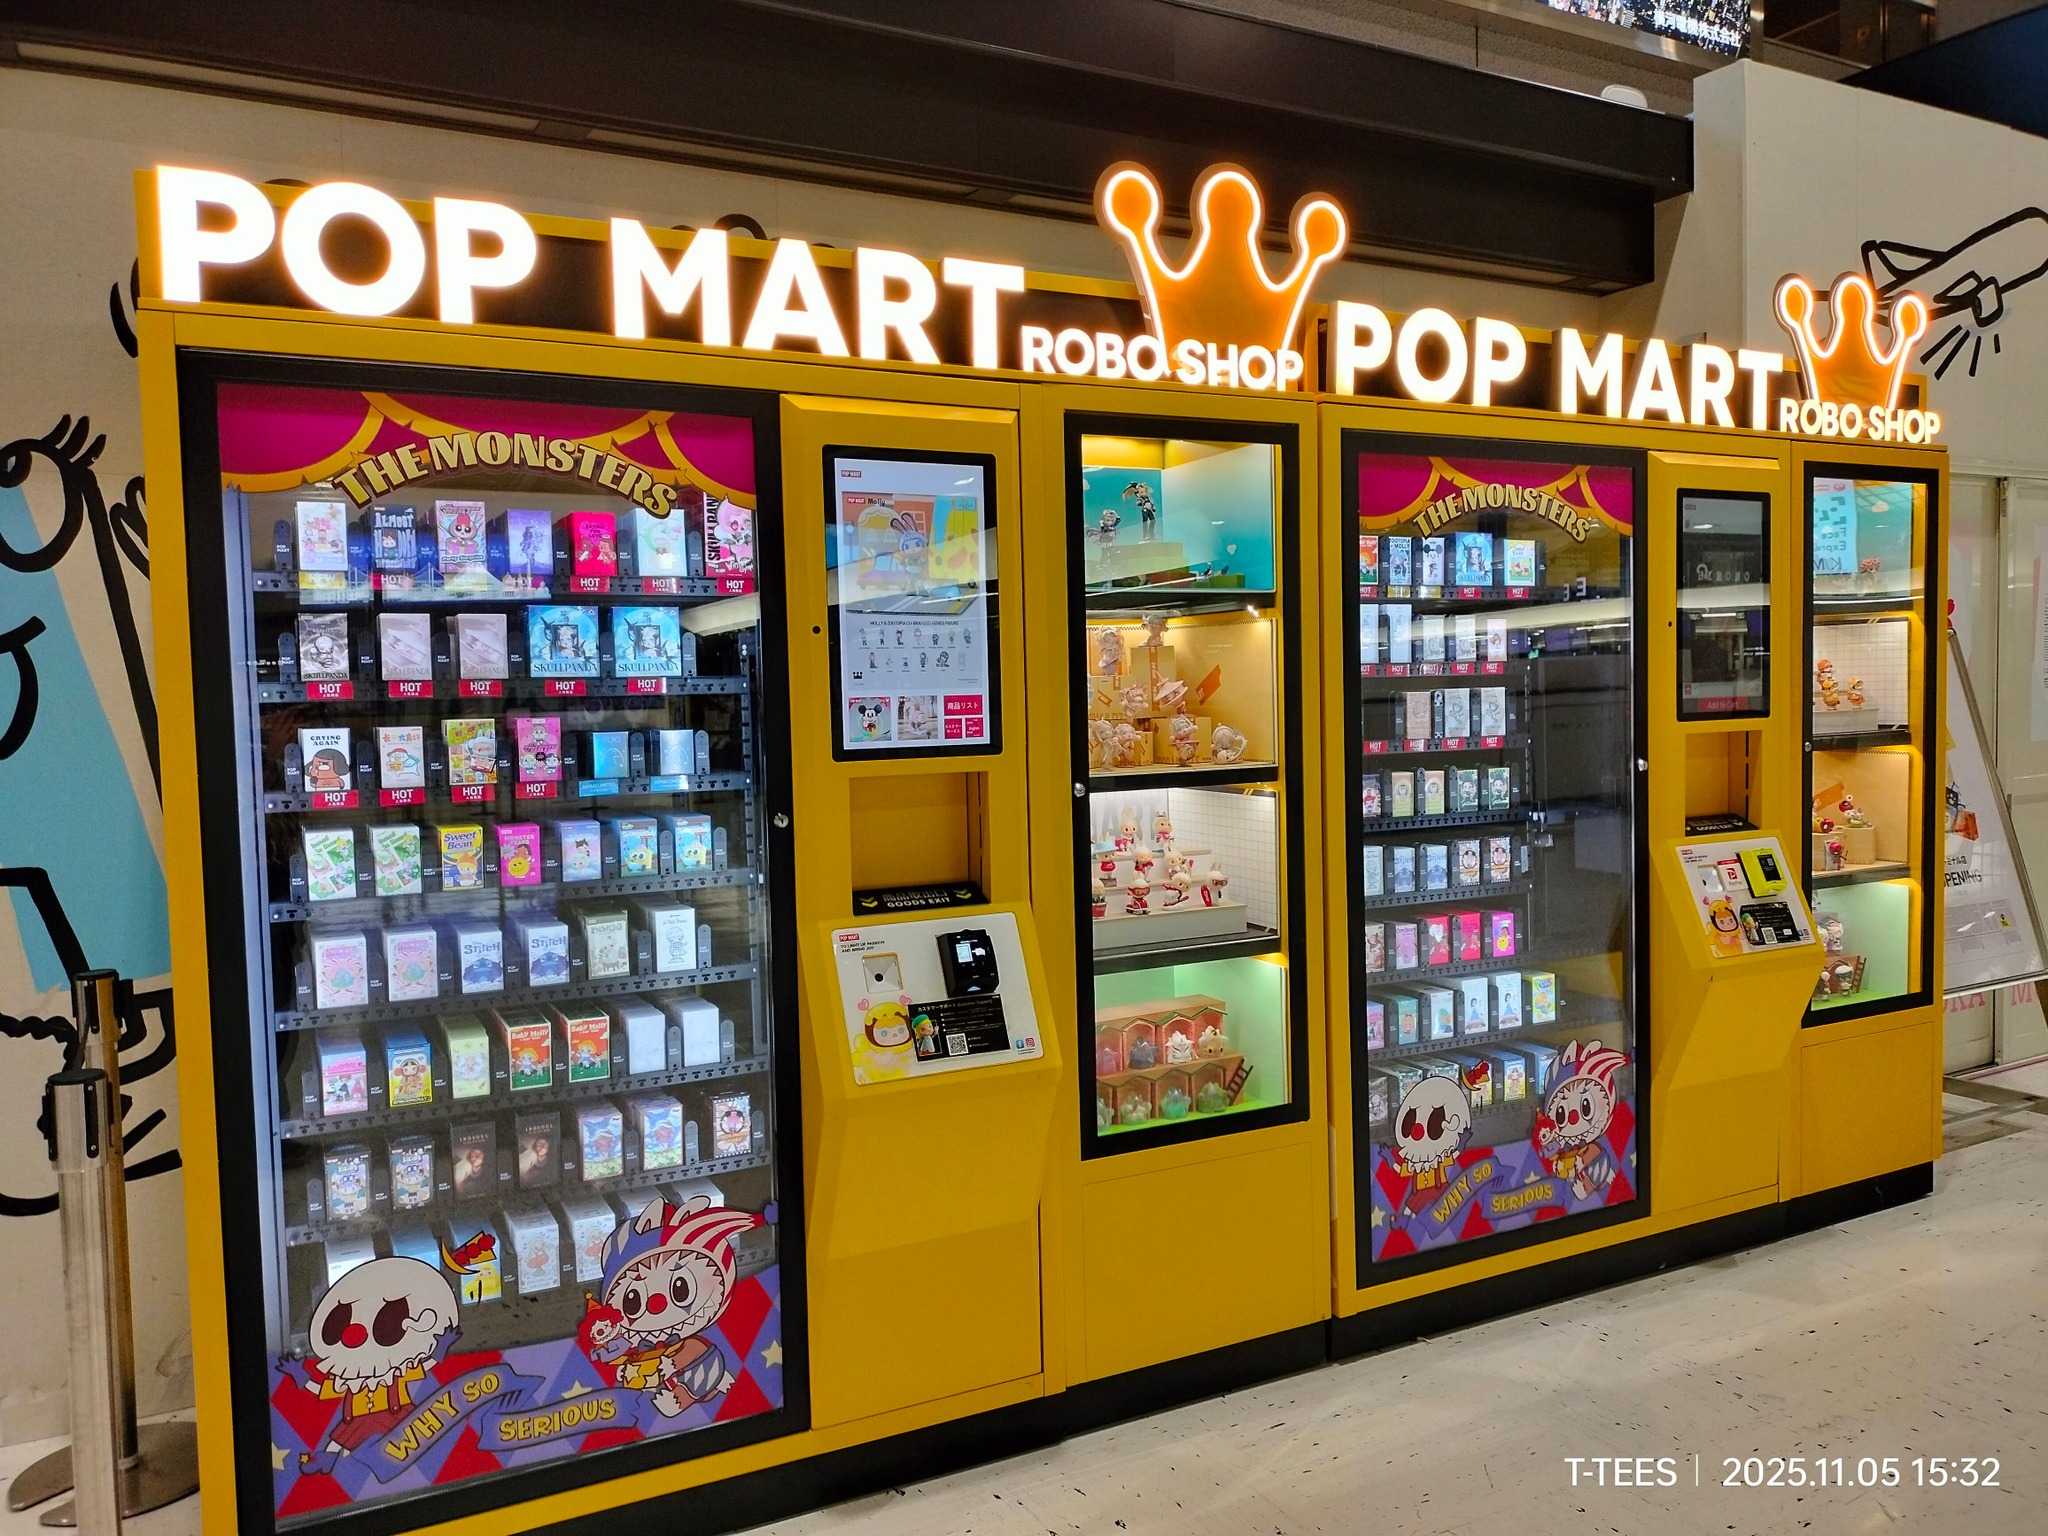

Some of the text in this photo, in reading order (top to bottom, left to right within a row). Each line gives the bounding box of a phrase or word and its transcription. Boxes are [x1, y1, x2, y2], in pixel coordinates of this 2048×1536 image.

[157, 165, 1025, 369] POP MART
[1021, 325, 1304, 391] ROBO SHOP
[1336, 301, 1784, 431] POP MART
[1778, 398, 1941, 444] ROBO SHOP
[332, 431, 679, 517] THE MONSTERS
[867, 498, 886, 507] Molly
[1413, 483, 1591, 542] THE MONSTERS
[374, 511, 414, 528] ALMOST
[381, 574, 402, 585] HOT
[580, 578, 600, 587] HOT
[652, 579, 670, 588] HOT
[726, 580, 744, 589] HOT
[533, 662, 599, 673] SKULLPANDA
[1456, 663, 1469, 671] HOT
[303, 671, 348, 680] SKULLPANDA
[319, 683, 341, 694] HOT
[400, 682, 422, 692] HOT
[470, 681, 491, 691] HOT
[555, 681, 576, 691] HOT
[637, 679, 657, 688] HOT
[947, 701, 979, 711] 商品リスト
[1707, 701, 1719, 709] Add
[1727, 700, 1740, 708] Cart
[1486, 736, 1498, 744] HOT
[1369, 742, 1381, 750] HOT
[462, 786, 484, 796] HOT
[526, 783, 547, 793] HOT
[325, 792, 347, 802] HOT
[392, 789, 413, 799] HOT
[444, 831, 476, 842] Sweet
[447, 841, 473, 850] Bean
[1944, 868, 1982, 888] PENING
[886, 896, 950, 908] GOODS EXIT
[591, 924, 623, 935] DIMOO
[570, 1021, 607, 1033] Baby Molly
[511, 1028, 549, 1040] Baby Molly
[1433, 1162, 1493, 1225] WHY SO
[1492, 1184, 1553, 1213] SERIOUS
[385, 1372, 501, 1463] WHY SO
[500, 1399, 617, 1443] SERIOUS
